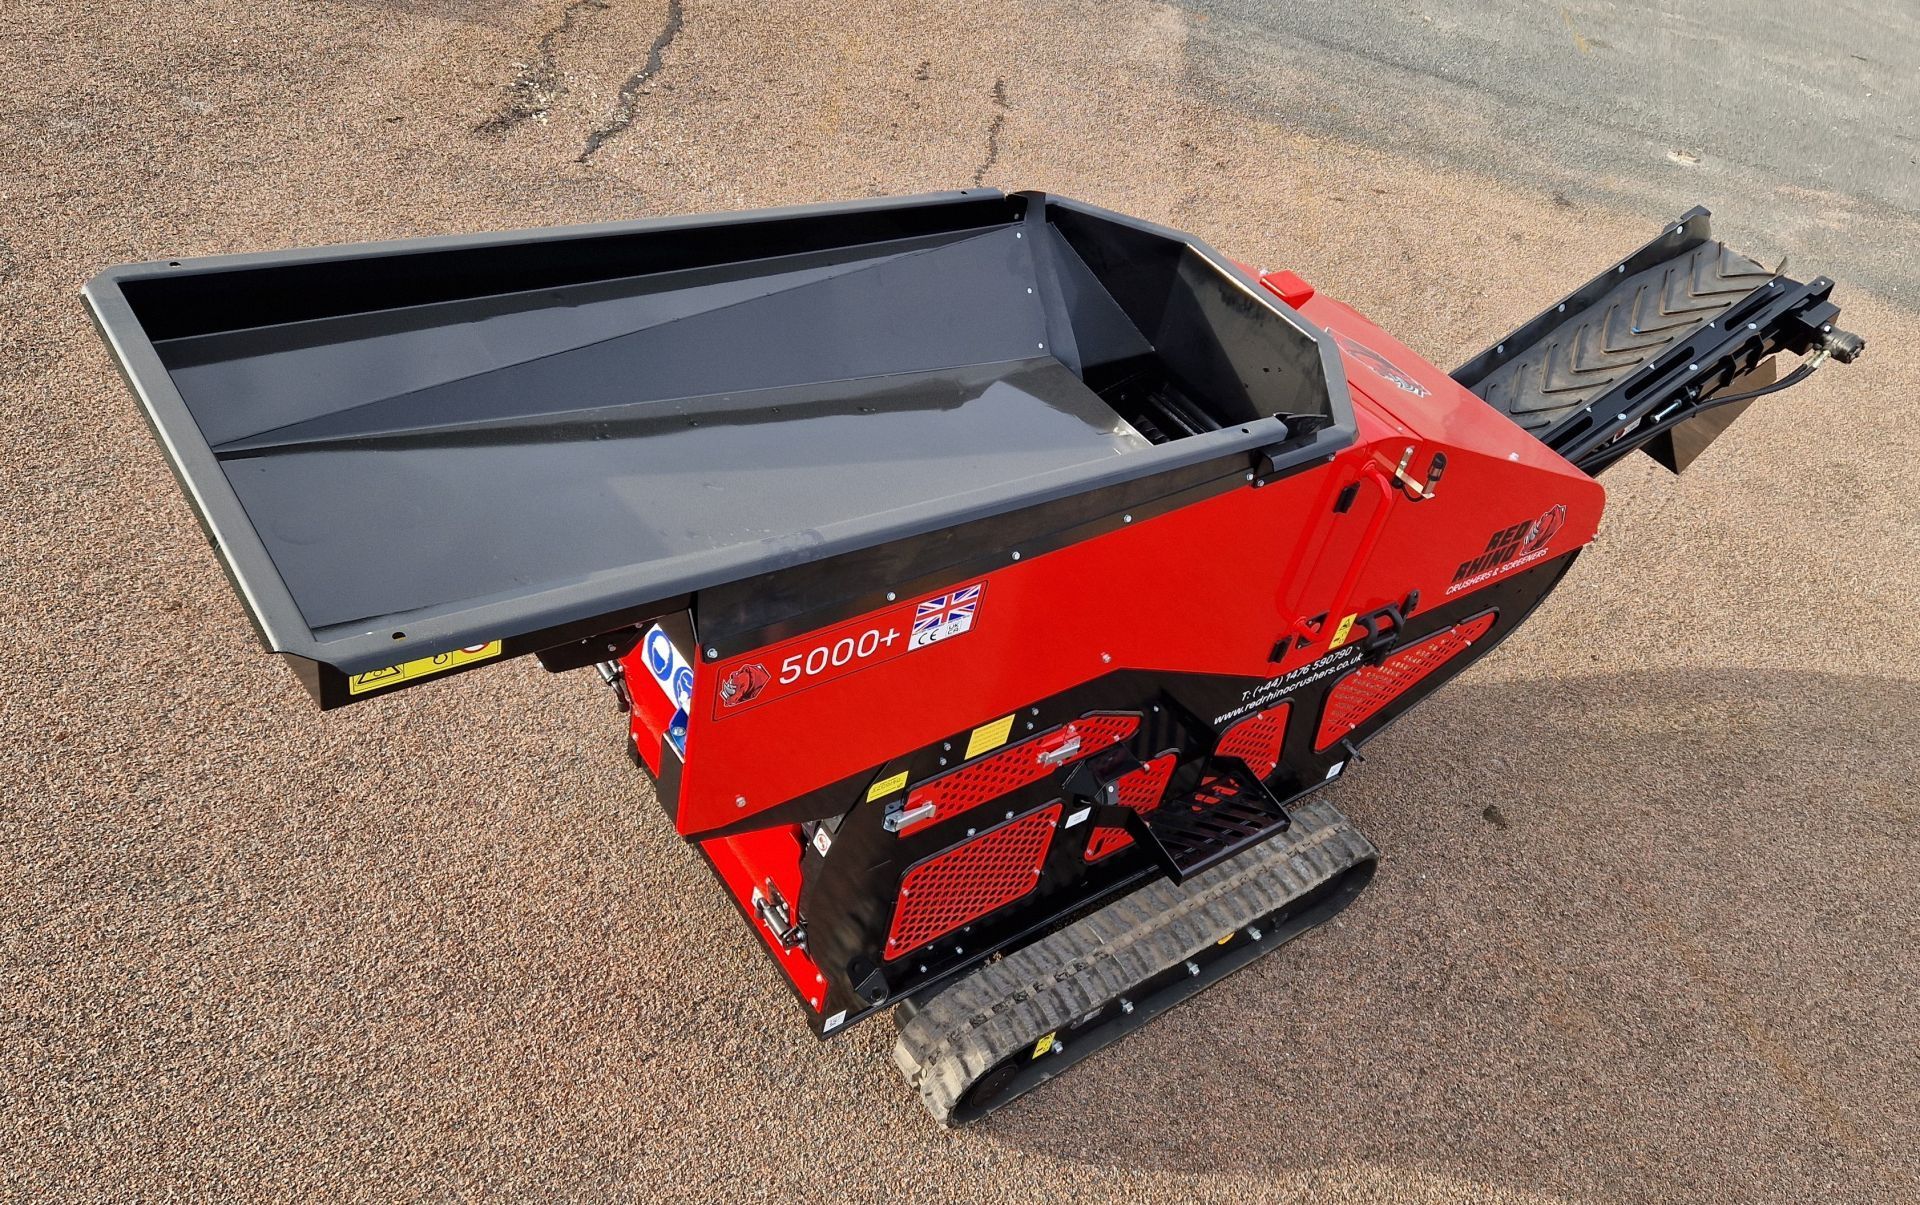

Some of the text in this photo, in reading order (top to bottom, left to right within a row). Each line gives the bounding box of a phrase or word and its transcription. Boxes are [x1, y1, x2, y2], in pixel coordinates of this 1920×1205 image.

[1484, 519, 1532, 553] RED
[1446, 548, 1548, 595] CRUSHERS & SCREENERS
[1451, 541, 1520, 582] RHINO
[779, 628, 900, 685] 5000+
[918, 628, 940, 645] CE
[1213, 652, 1364, 725] www.redrhinocrushers.co.uk
[1241, 646, 1353, 702] T: (+44) 1476 590790
